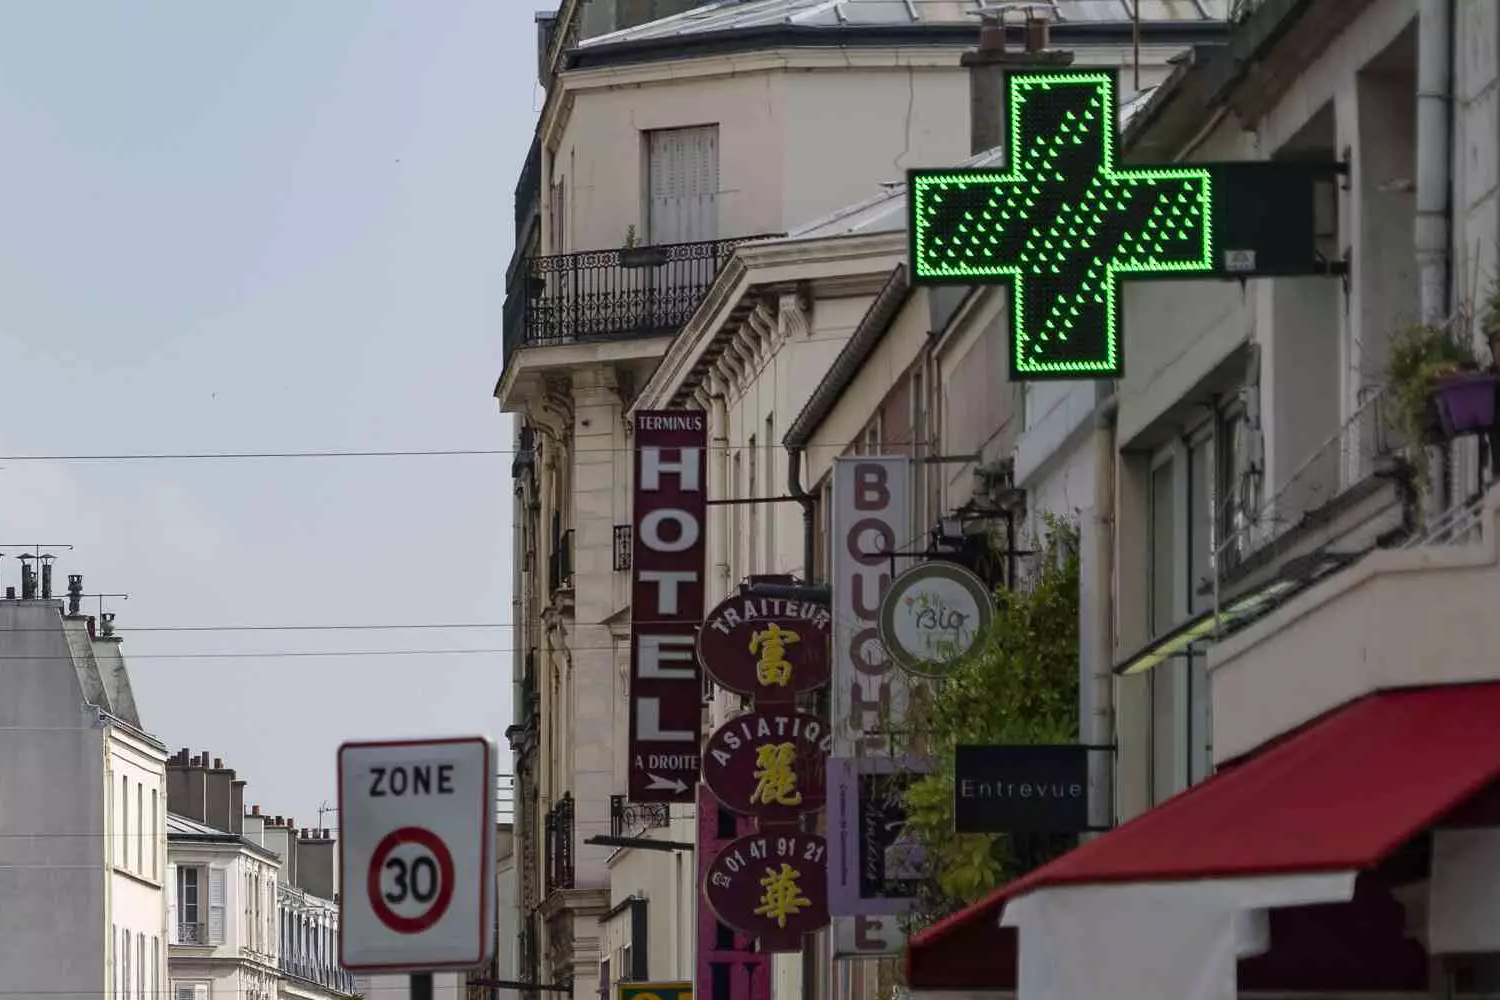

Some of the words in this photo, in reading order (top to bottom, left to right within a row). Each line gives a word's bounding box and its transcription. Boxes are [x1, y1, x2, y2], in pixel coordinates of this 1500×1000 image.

[639, 416, 702, 431] TERMINUS
[635, 446, 700, 741] HOTEL
[710, 599, 831, 637] TRAITEUR
[710, 716, 834, 767] ASIATIQU
[368, 764, 455, 797] ZONE
[649, 755, 699, 770] DROITE
[961, 778, 1082, 798] Entrevue
[725, 850, 747, 873] 01
[749, 838, 767, 859] 47
[777, 837, 796, 857] 91
[804, 842, 825, 863] 21
[384, 855, 439, 905] 30
